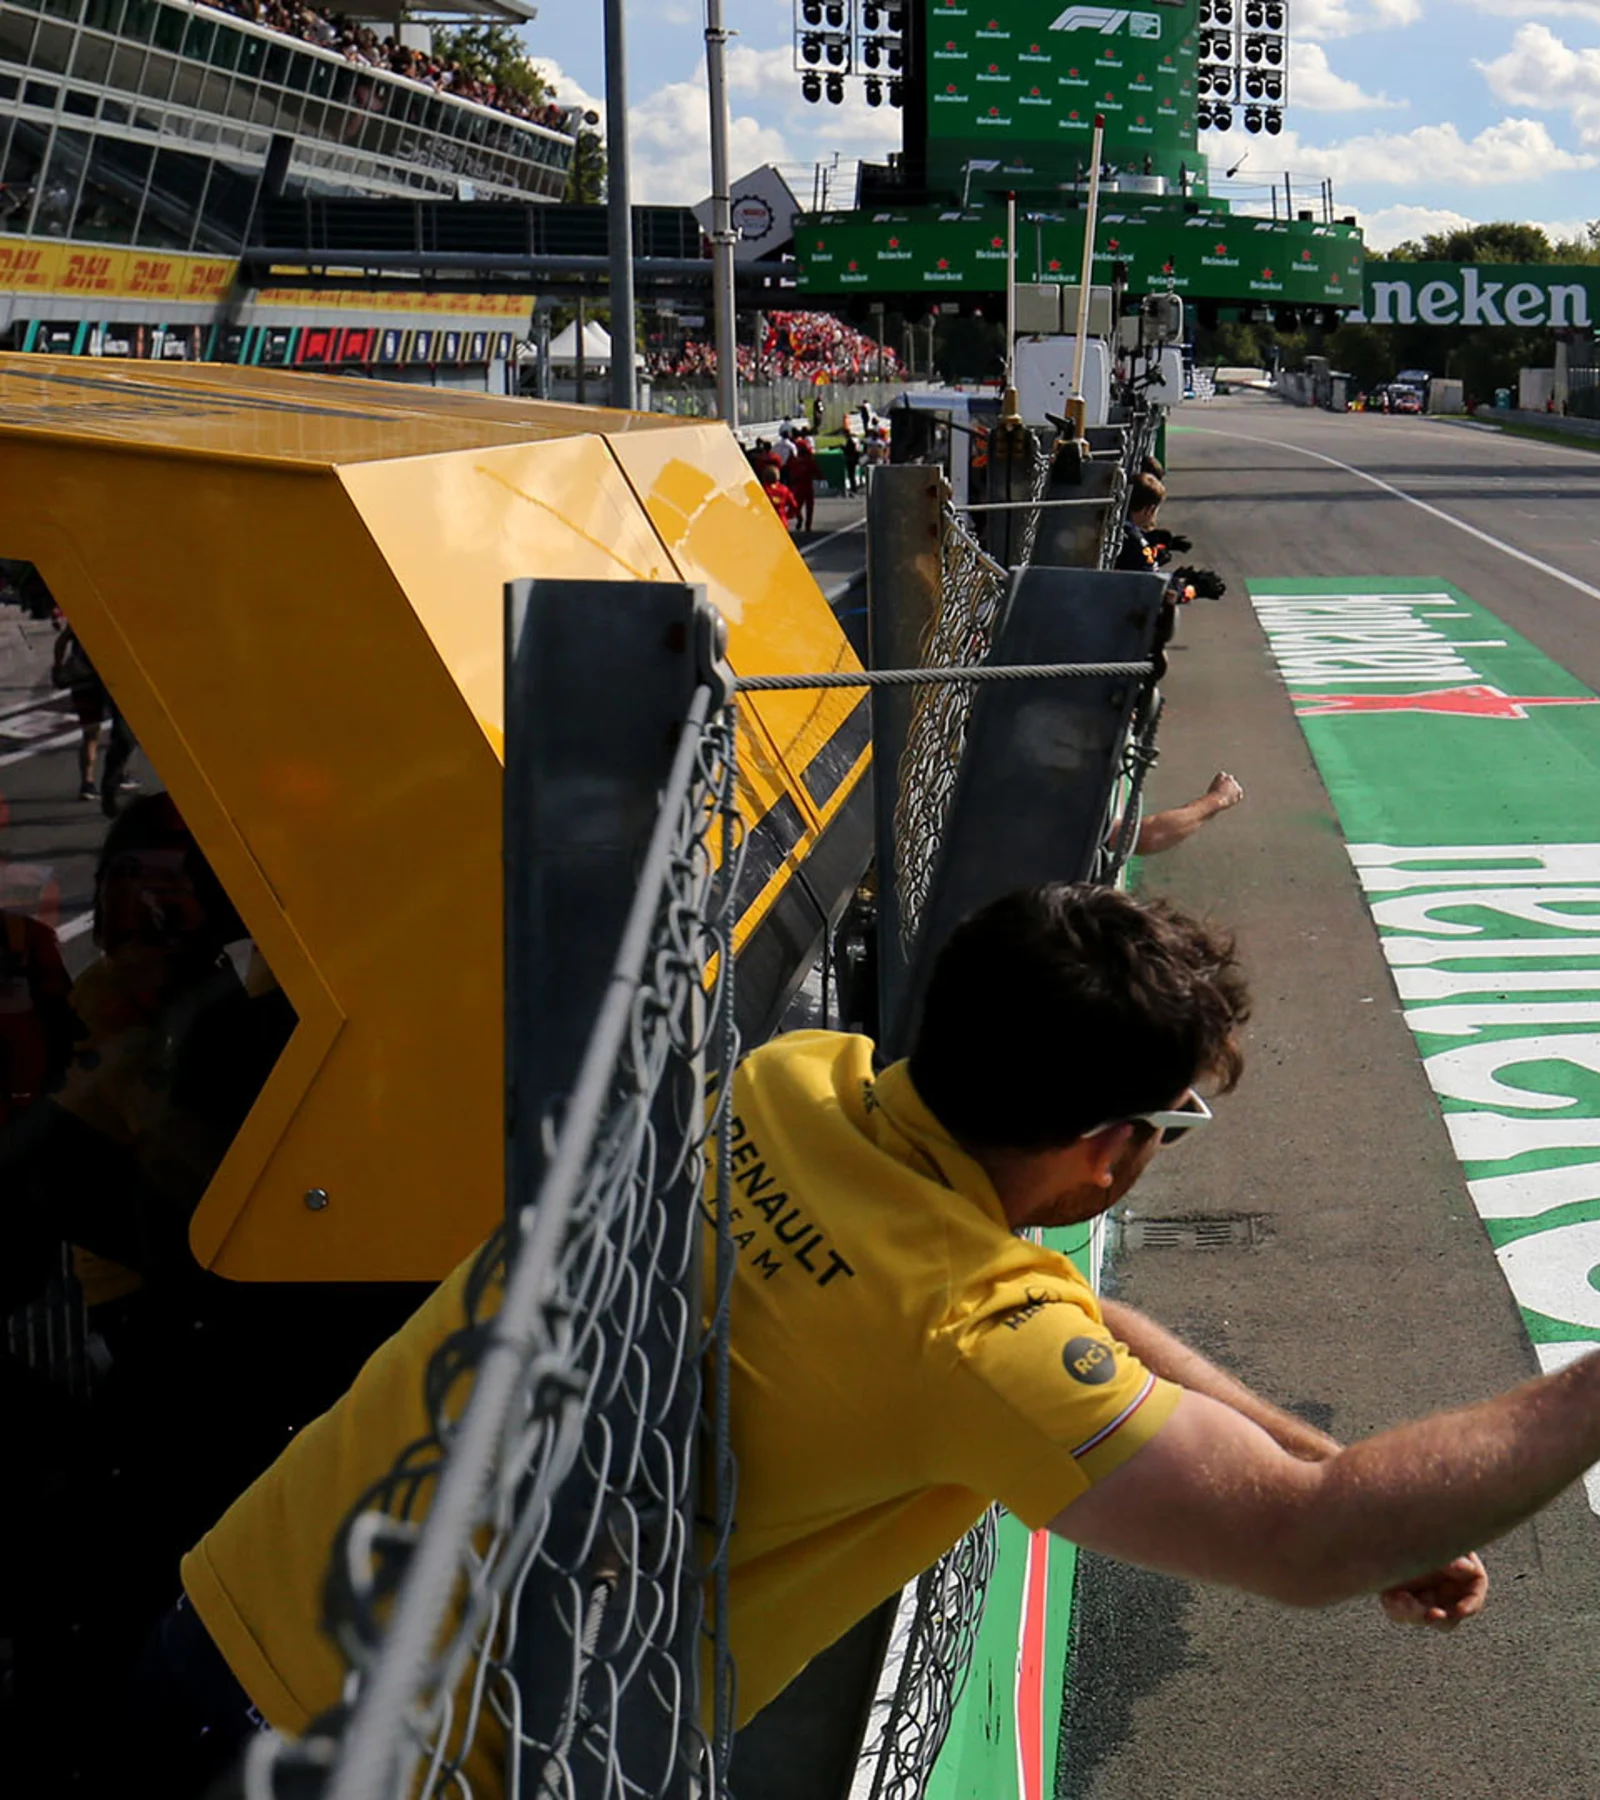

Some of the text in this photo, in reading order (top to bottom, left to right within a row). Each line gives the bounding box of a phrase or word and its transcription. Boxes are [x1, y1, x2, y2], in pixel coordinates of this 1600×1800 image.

[1048, 5, 1130, 35] F1
[976, 250, 1018, 259] Heinekn
[1345, 267, 1592, 327] neken
[1250, 592, 1508, 686] Heineken
